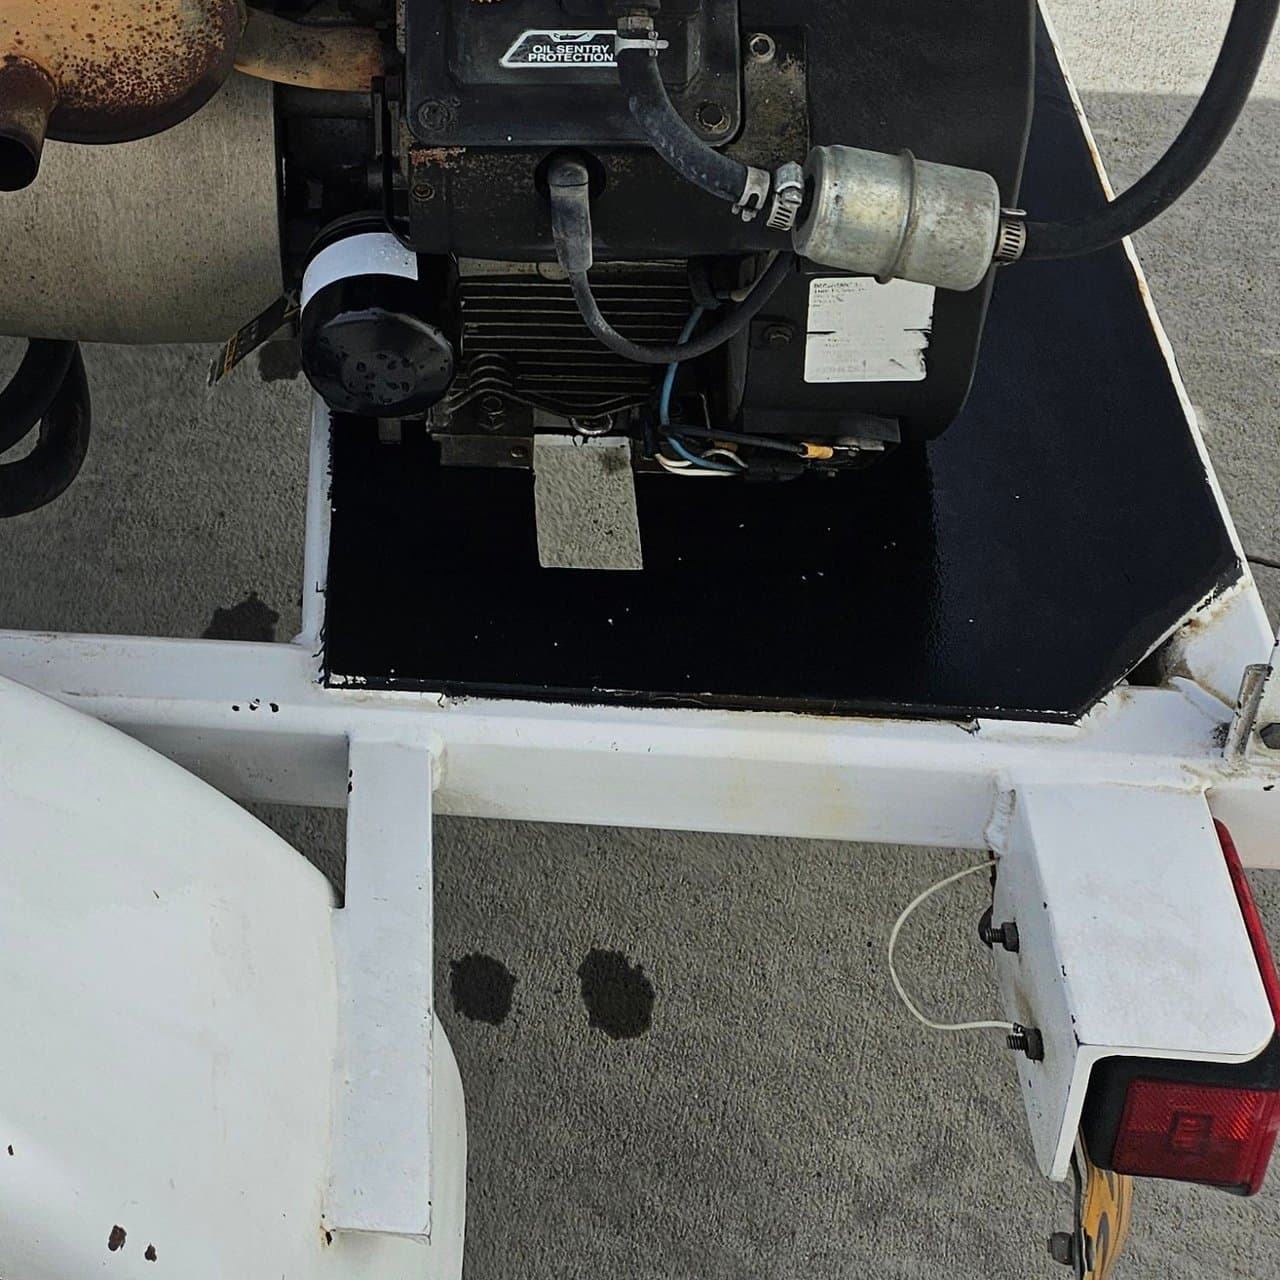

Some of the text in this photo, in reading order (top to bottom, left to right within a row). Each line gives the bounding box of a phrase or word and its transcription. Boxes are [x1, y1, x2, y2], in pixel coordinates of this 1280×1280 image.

[532, 44, 610, 54] OIL SENTRY
[528, 53, 614, 62] PROTECTION
